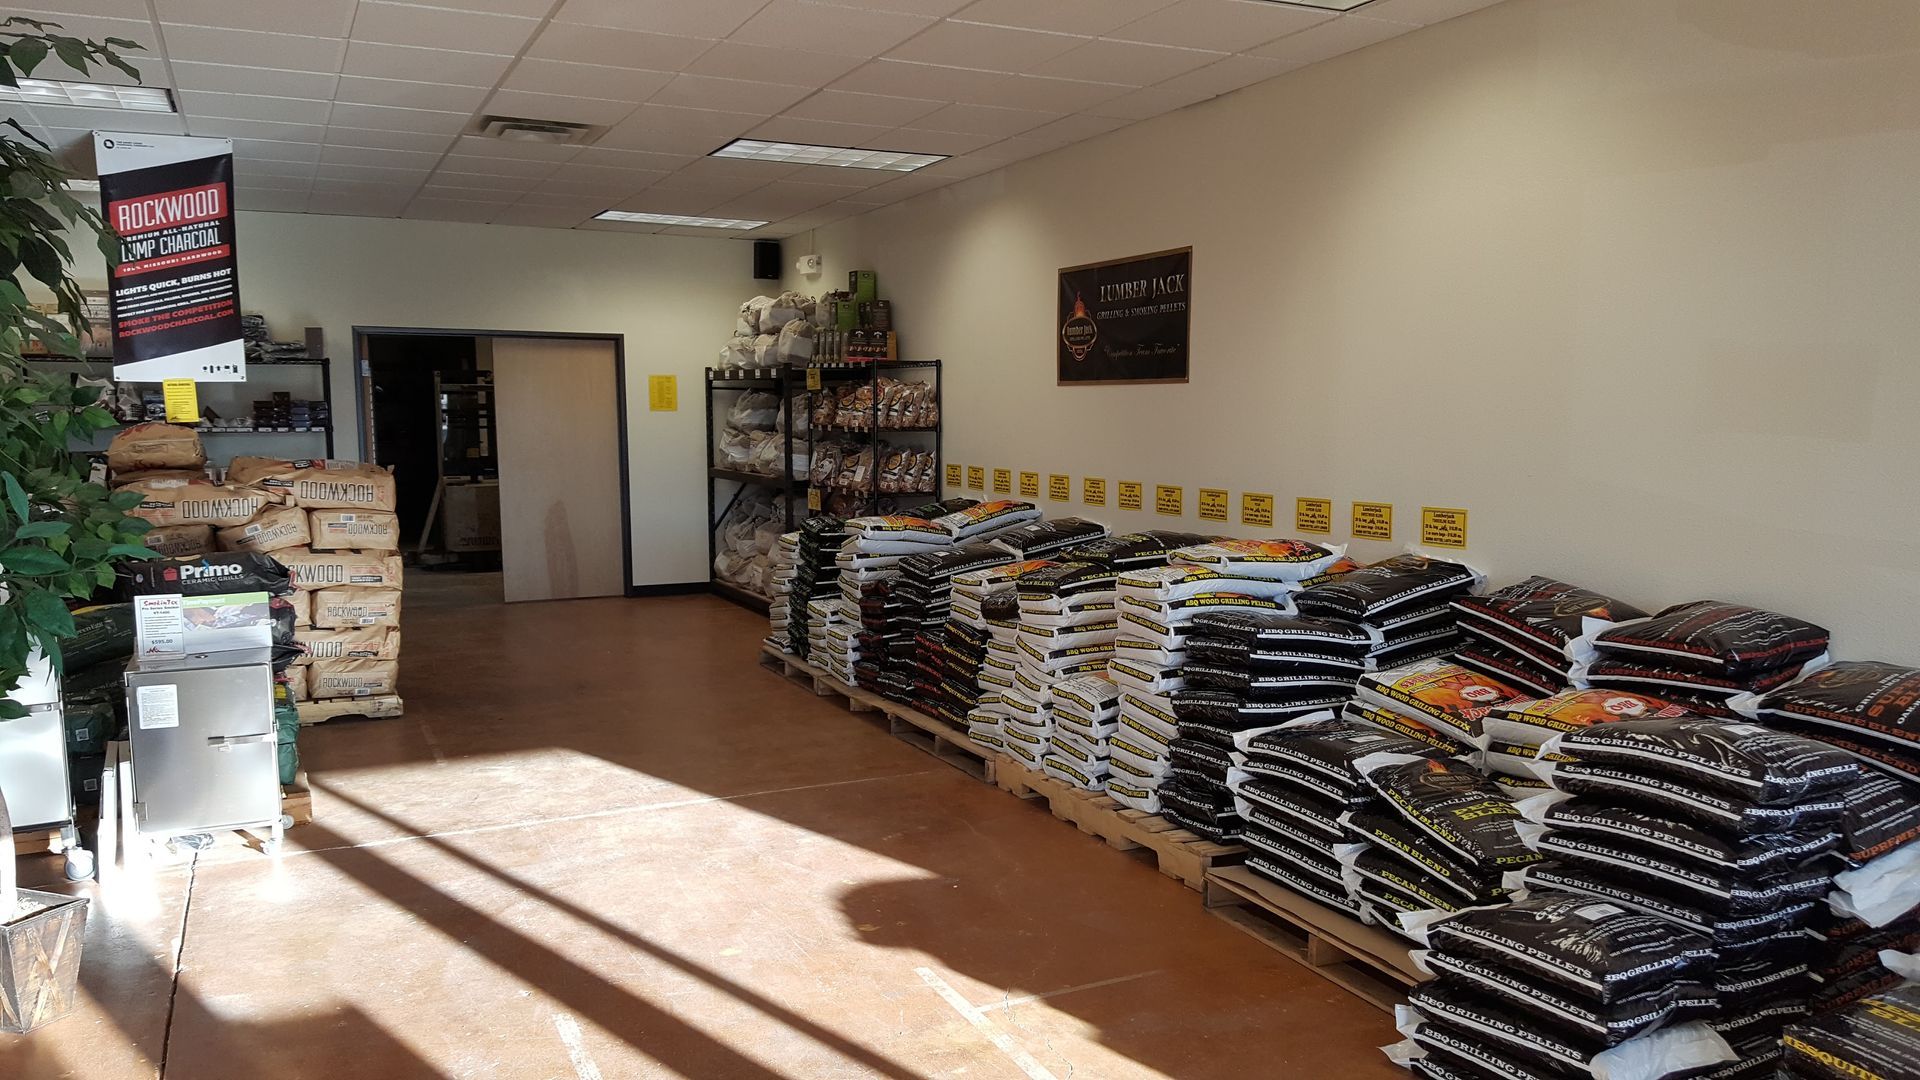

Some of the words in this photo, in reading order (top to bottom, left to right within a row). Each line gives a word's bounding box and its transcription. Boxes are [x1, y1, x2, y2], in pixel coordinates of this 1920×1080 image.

[118, 188, 219, 231] ROCKWOOD
[121, 231, 160, 242] REMIUM
[163, 220, 220, 235] ALL-NATURAL
[121, 239, 156, 263] LUMP
[160, 227, 221, 255] CHARCOAL
[144, 258, 179, 268] MISSOURI
[181, 250, 222, 262] HARDWOOD
[115, 285, 148, 297] LIGHTS
[149, 279, 180, 291] QUICK,
[181, 272, 212, 284] BURNS
[213, 268, 232, 277] HOT
[1100, 279, 1148, 302] LUMBER
[1152, 274, 1185, 299] JACK
[119, 317, 150, 328] SMOKE
[152, 313, 170, 321] THE
[172, 299, 233, 317] COMPETITION
[1096, 309, 1124, 320] GRILLING
[1131, 305, 1158, 316] SMOKING
[1160, 302, 1187, 313] PELLETS
[1041, 538, 1071, 549] GRILLING
[1072, 531, 1101, 542] PELLETS
[180, 563, 242, 580] Primo
[182, 577, 216, 585] CERAMIC
[218, 574, 244, 582] GRILLS
[949, 561, 980, 574] GRILLING
[1080, 572, 1109, 581] PECAN
[1367, 599, 1386, 611] BBQ
[1386, 584, 1428, 602] GRILLING
[1428, 574, 1467, 588] PELLETS
[1383, 617, 1400, 626] BBQ
[1401, 605, 1441, 621] GRILLING
[1460, 599, 1522, 629] COMPETITION
[1523, 623, 1558, 645] BLEND
[1284, 628, 1321, 636] GRILLING
[1322, 631, 1366, 640] PELLETS
[1389, 631, 1429, 646] GRILLING
[1275, 650, 1321, 659] GRILLING
[1192, 667, 1226, 675] GRILLING
[1465, 688, 1492, 698] BBQ
[1160, 711, 1176, 724] PELLETS
[1376, 684, 1389, 696] BBQ
[1389, 690, 1409, 704] WOOD
[1409, 698, 1440, 717] GRILLING
[1440, 713, 1471, 732] PELLETS
[1507, 712, 1522, 720] BBQ
[1524, 715, 1546, 726] WOOD
[1784, 703, 1866, 725] SUPREME
[1362, 710, 1375, 721] BBQ
[1375, 716, 1394, 729] WOOD
[1395, 723, 1427, 741] GRILLING
[1427, 738, 1457, 753] PELLETS
[1269, 744, 1309, 760] GRILLING
[1310, 757, 1350, 778] PELLETS
[1507, 745, 1521, 754] BBQ
[1571, 735, 1600, 745] BBQ
[1601, 737, 1675, 756] GRILLING
[1677, 751, 1752, 778] PELLETS
[1264, 763, 1303, 778] GRILLING
[1304, 775, 1343, 796] PELLETS
[1564, 765, 1592, 775] BBQ
[1593, 768, 1660, 787] GRILLING
[1661, 782, 1731, 810] PELLETS
[1244, 785, 1260, 795] BBQ
[1260, 791, 1300, 811] GRILLING
[1301, 807, 1339, 829] PELLETS
[1386, 788, 1419, 818] PECAN
[1419, 815, 1456, 843] BLEND
[1254, 812, 1270, 823] BBQ
[1270, 818, 1308, 840] GRILLING
[1553, 812, 1581, 822] BBQ
[1582, 815, 1651, 836] GRILLING
[1653, 831, 1725, 859] PELLETS
[1245, 831, 1261, 842] BBQ
[1261, 837, 1301, 859] GRILLING
[1302, 855, 1339, 877] PELLETS
[1375, 829, 1410, 855] PECAN
[1411, 850, 1451, 877] BLEND
[1496, 853, 1543, 865] PECAN
[1548, 837, 1576, 848] BBQ
[1577, 841, 1647, 865] GRILLING
[1649, 859, 1720, 888] PELLETS
[1252, 857, 1270, 868] BBQ
[1270, 865, 1312, 889] GRILLING
[1313, 886, 1355, 908] PELLETS
[1381, 870, 1418, 893] PECAN
[1535, 871, 1563, 883] BBQ
[1563, 877, 1631, 901] GRILLING
[1632, 895, 1702, 923] PELLETS
[1464, 925, 1525, 951] GRILLING
[1527, 947, 1593, 979] PELLETS
[1628, 955, 1681, 978] GRILLING
[1437, 952, 1464, 969] BBQ
[1465, 964, 1529, 992] GRILLING
[1530, 988, 1596, 1022] PELLETS
[1737, 973, 1780, 990] GRILLING
[1419, 994, 1446, 1009] BBQ
[1446, 1004, 1515, 1034] GRILLING
[1517, 1029, 1583, 1060] PELLETS
[1424, 1028, 1450, 1044] BBQ
[1450, 1038, 1516, 1074] GRILLING
[1419, 1058, 1445, 1076] BBQ
